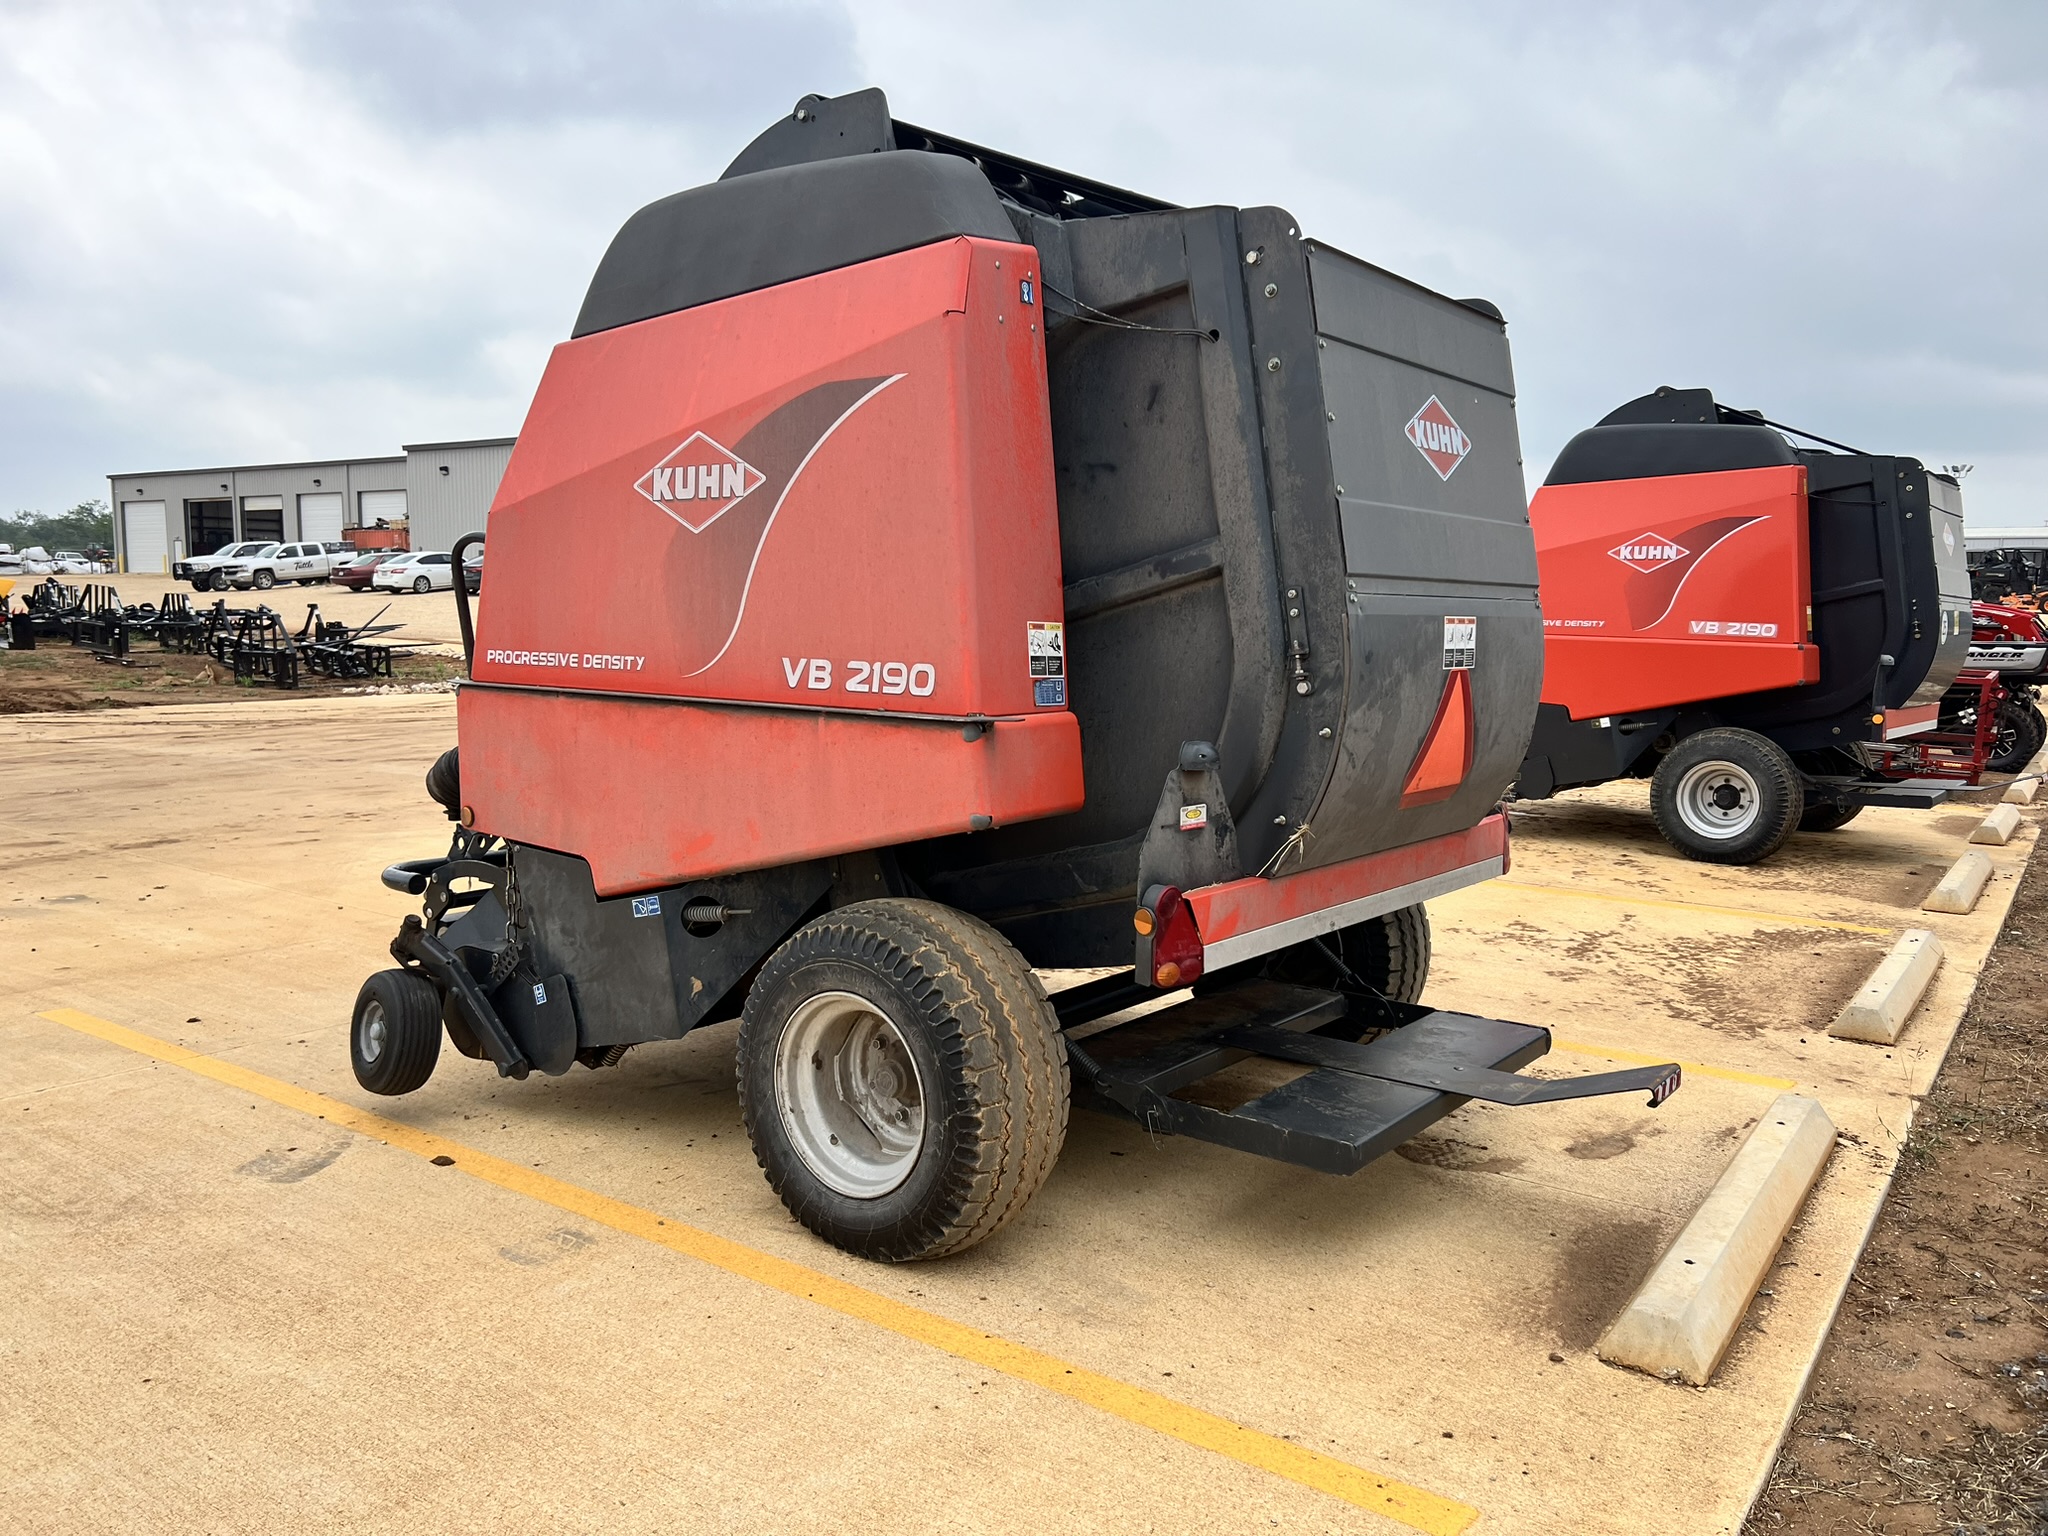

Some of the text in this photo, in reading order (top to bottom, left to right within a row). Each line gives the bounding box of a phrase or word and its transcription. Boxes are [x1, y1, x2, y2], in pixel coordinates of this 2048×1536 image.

[1413, 418, 1464, 457] KUHN
[652, 462, 746, 502] KUHN
[1620, 545, 1677, 560] KUHN
[1564, 620, 1605, 628] DENSITY
[1690, 620, 1776, 637] VB 2190
[486, 649, 645, 671] PROGRESSIVE DENSITY
[781, 656, 936, 697] VB 2190
